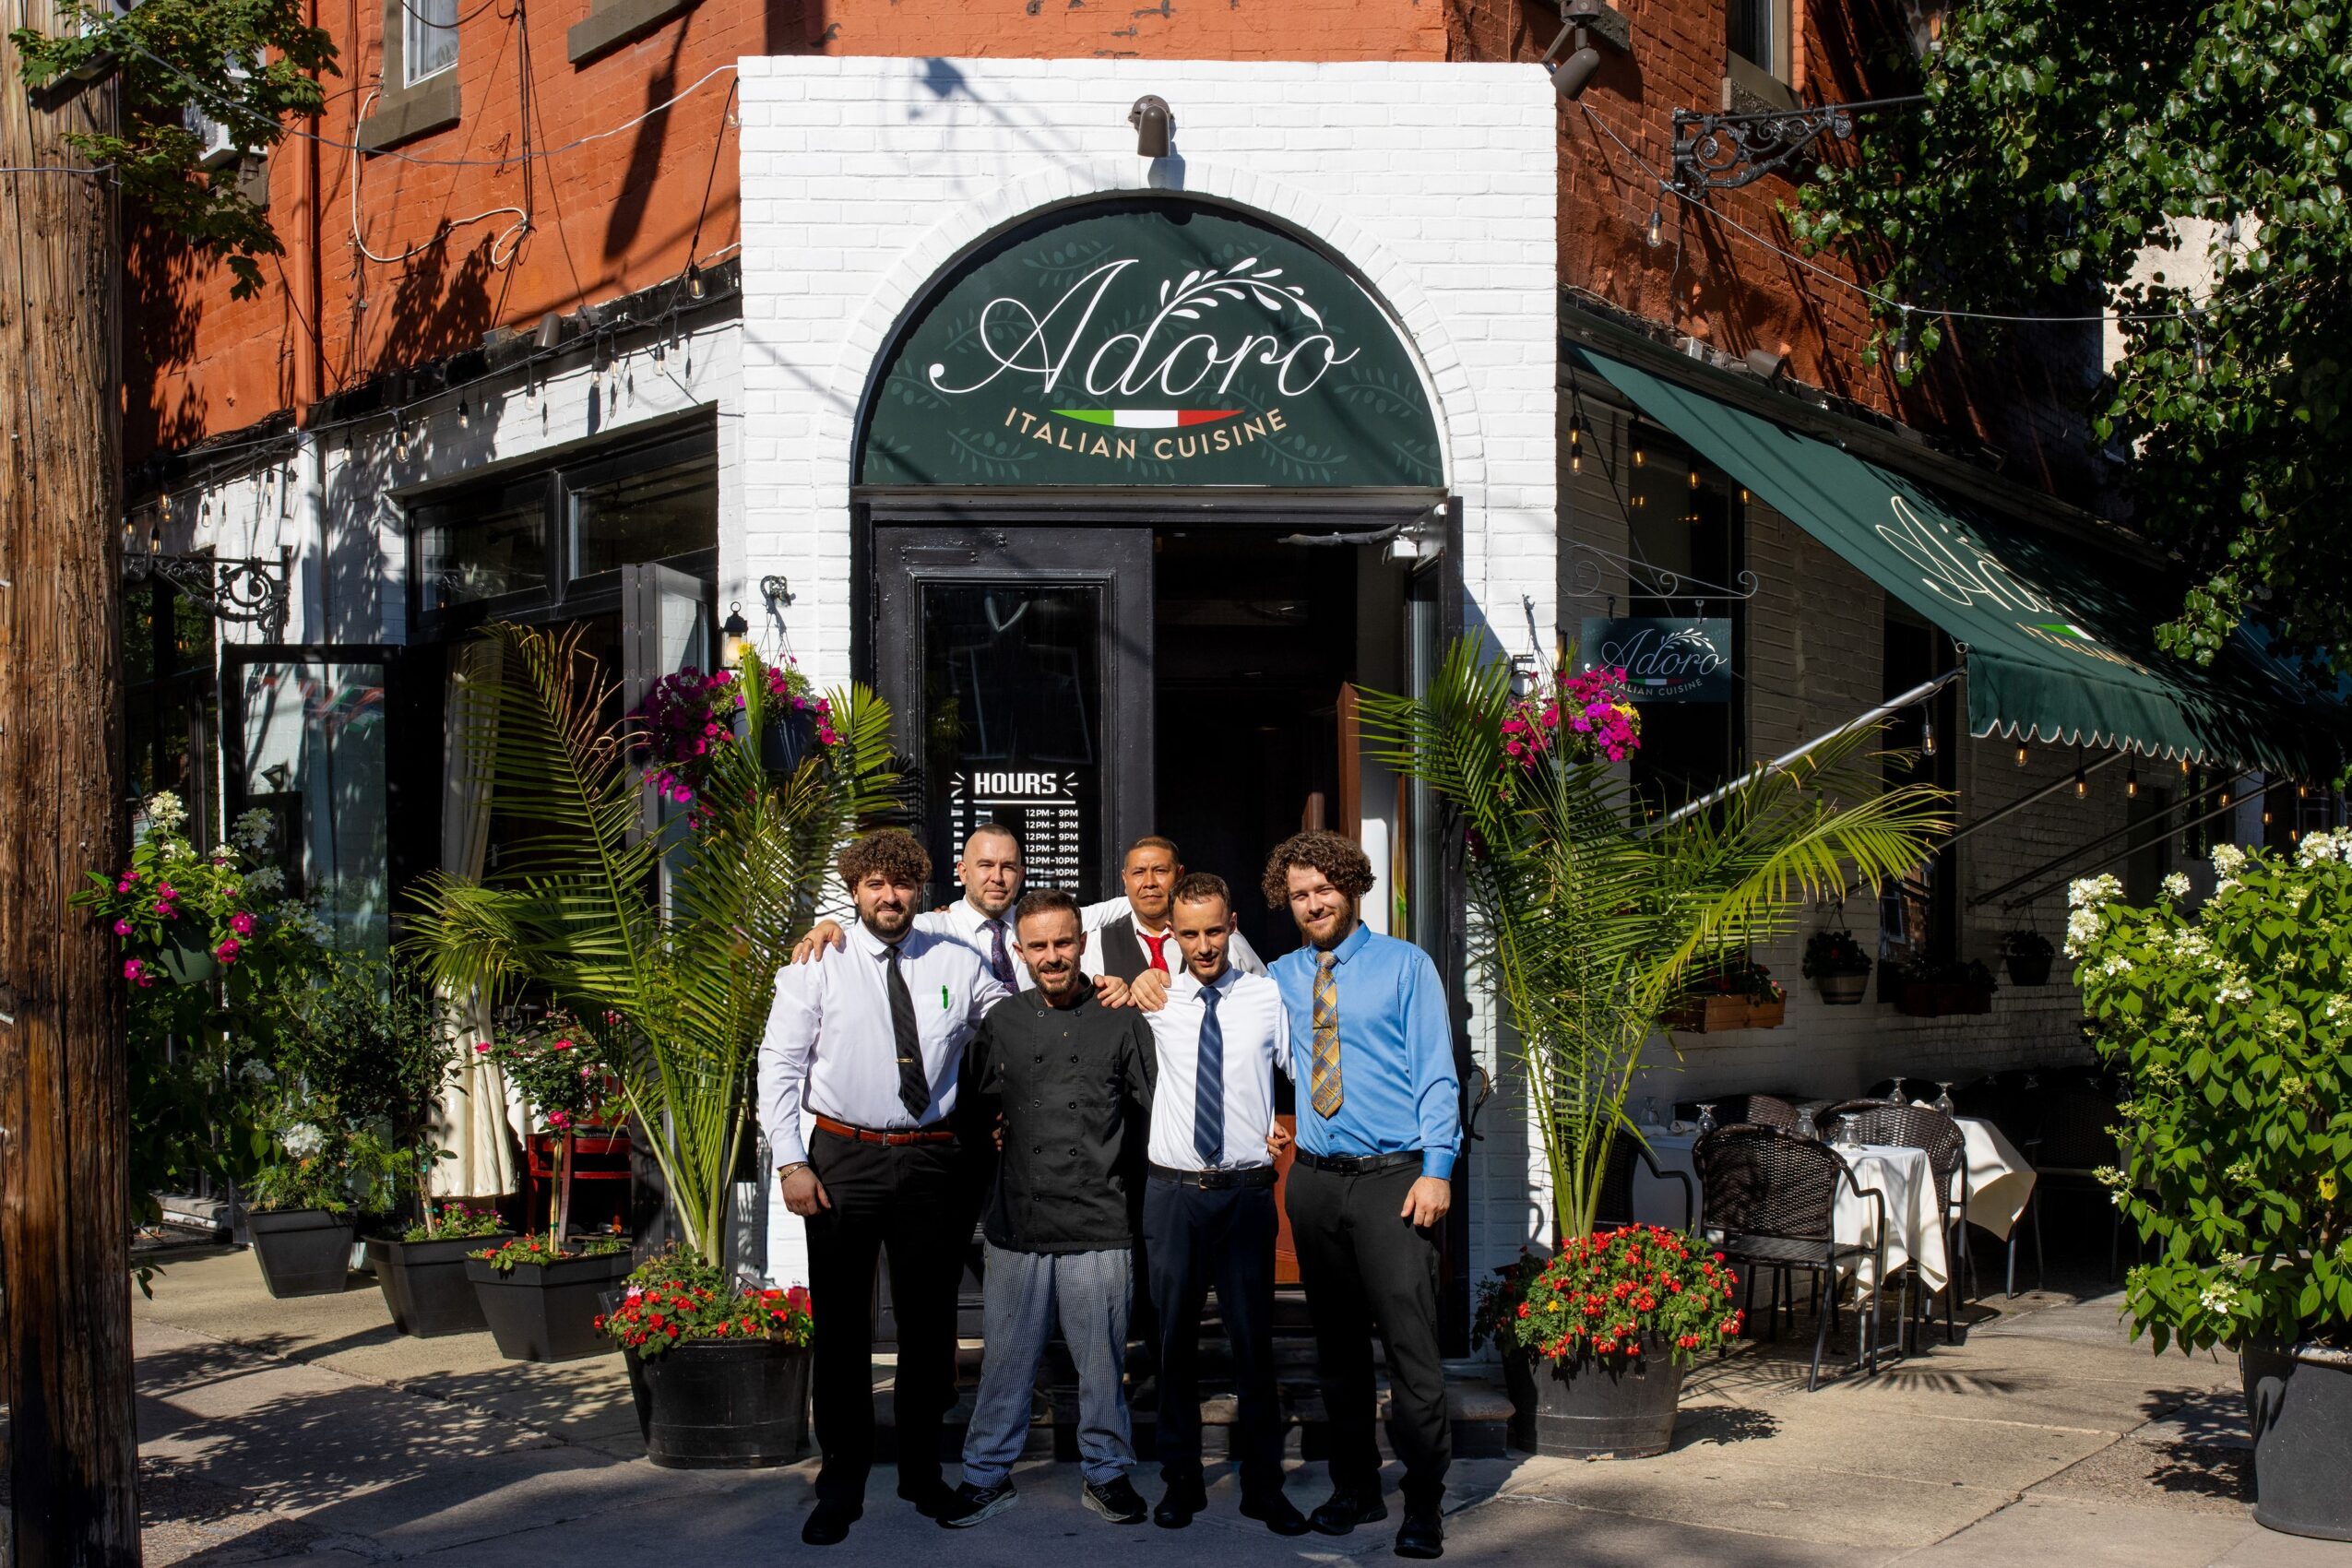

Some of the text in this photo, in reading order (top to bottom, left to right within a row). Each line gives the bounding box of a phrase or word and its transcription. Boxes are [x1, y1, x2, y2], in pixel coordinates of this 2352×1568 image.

[930, 257, 1360, 397] Adoro
[1004, 406, 1288, 460] ITALIAN CUISINE
[1584, 628, 1728, 675] Adoro
[1658, 678, 1703, 696] CUISINE
[974, 772, 1057, 795] HOURS
